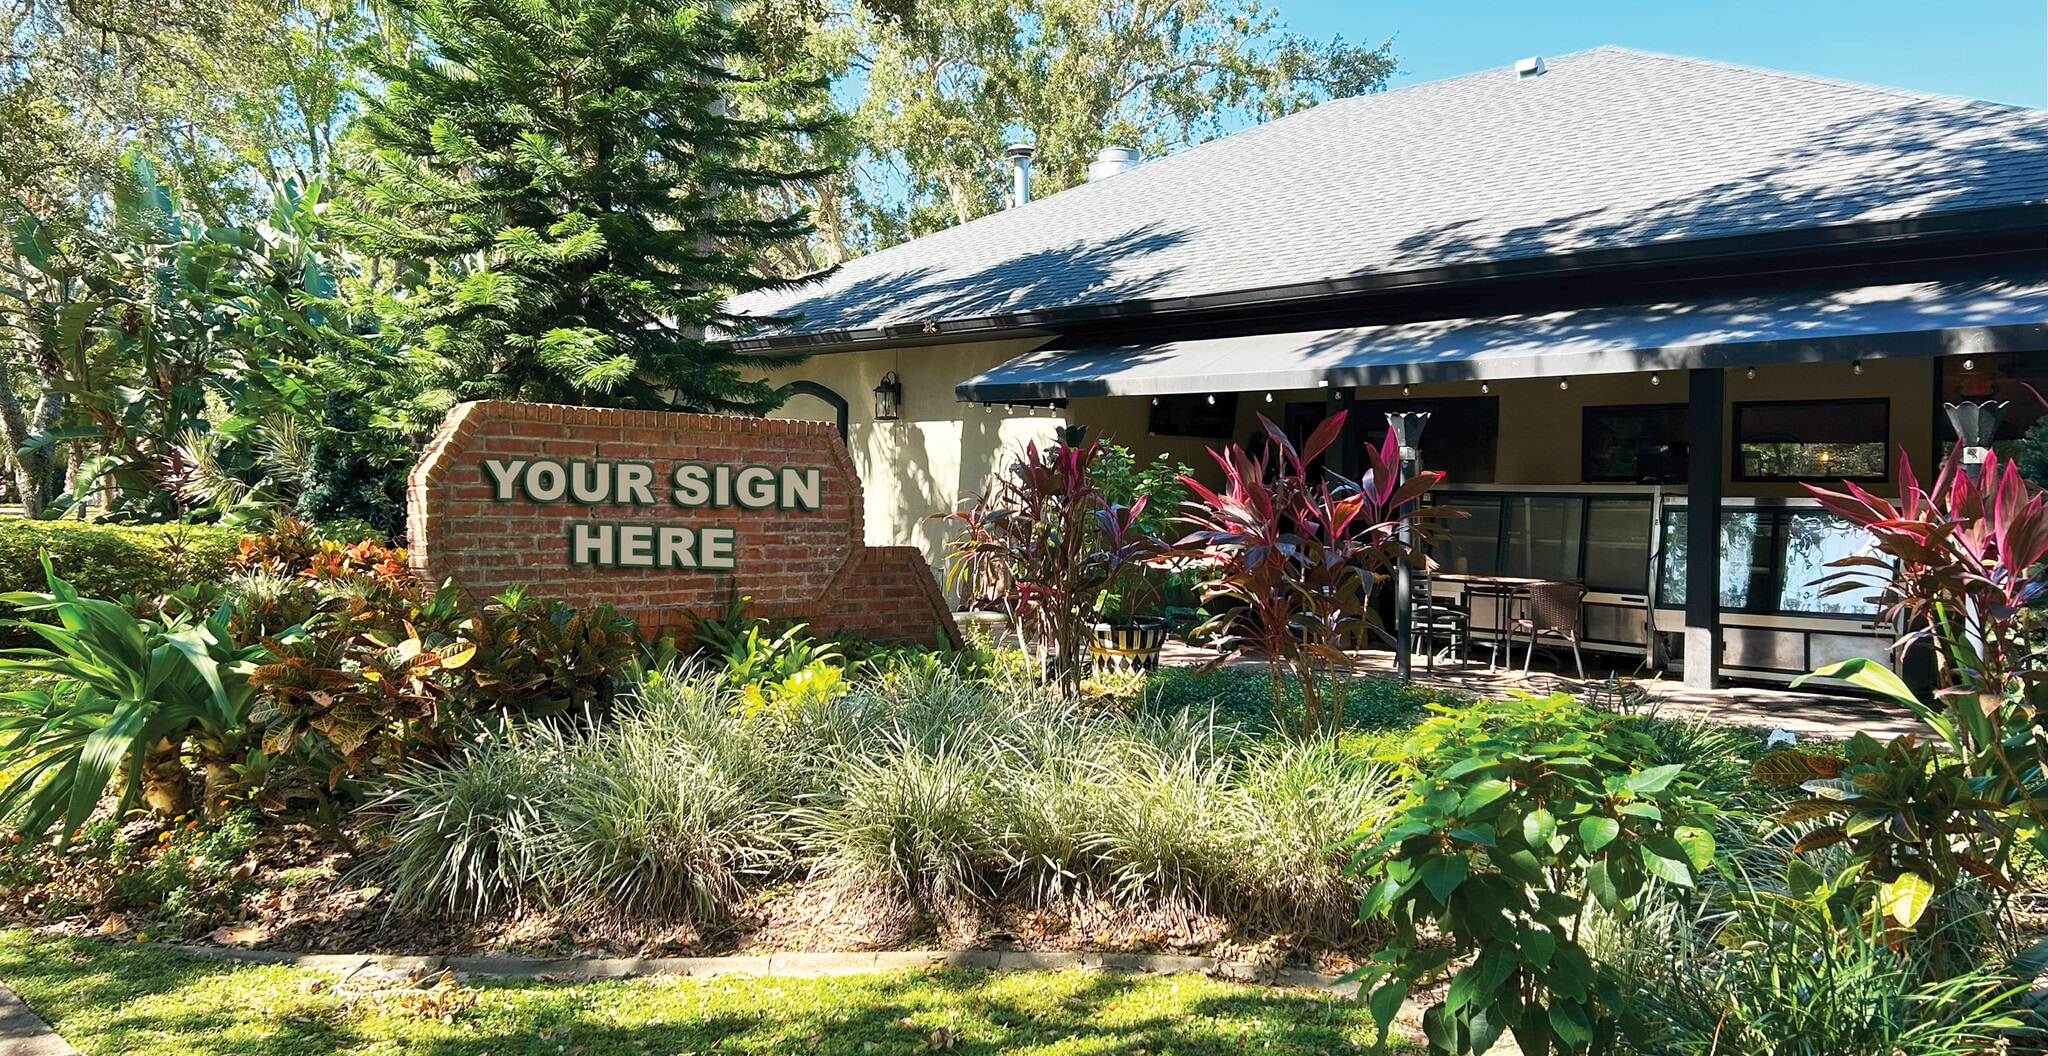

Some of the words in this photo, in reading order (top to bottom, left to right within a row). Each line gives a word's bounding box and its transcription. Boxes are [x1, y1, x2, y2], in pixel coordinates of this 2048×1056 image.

[484, 458, 656, 505] YOUR
[673, 464, 822, 510] SIGN
[573, 523, 736, 569] HERE
